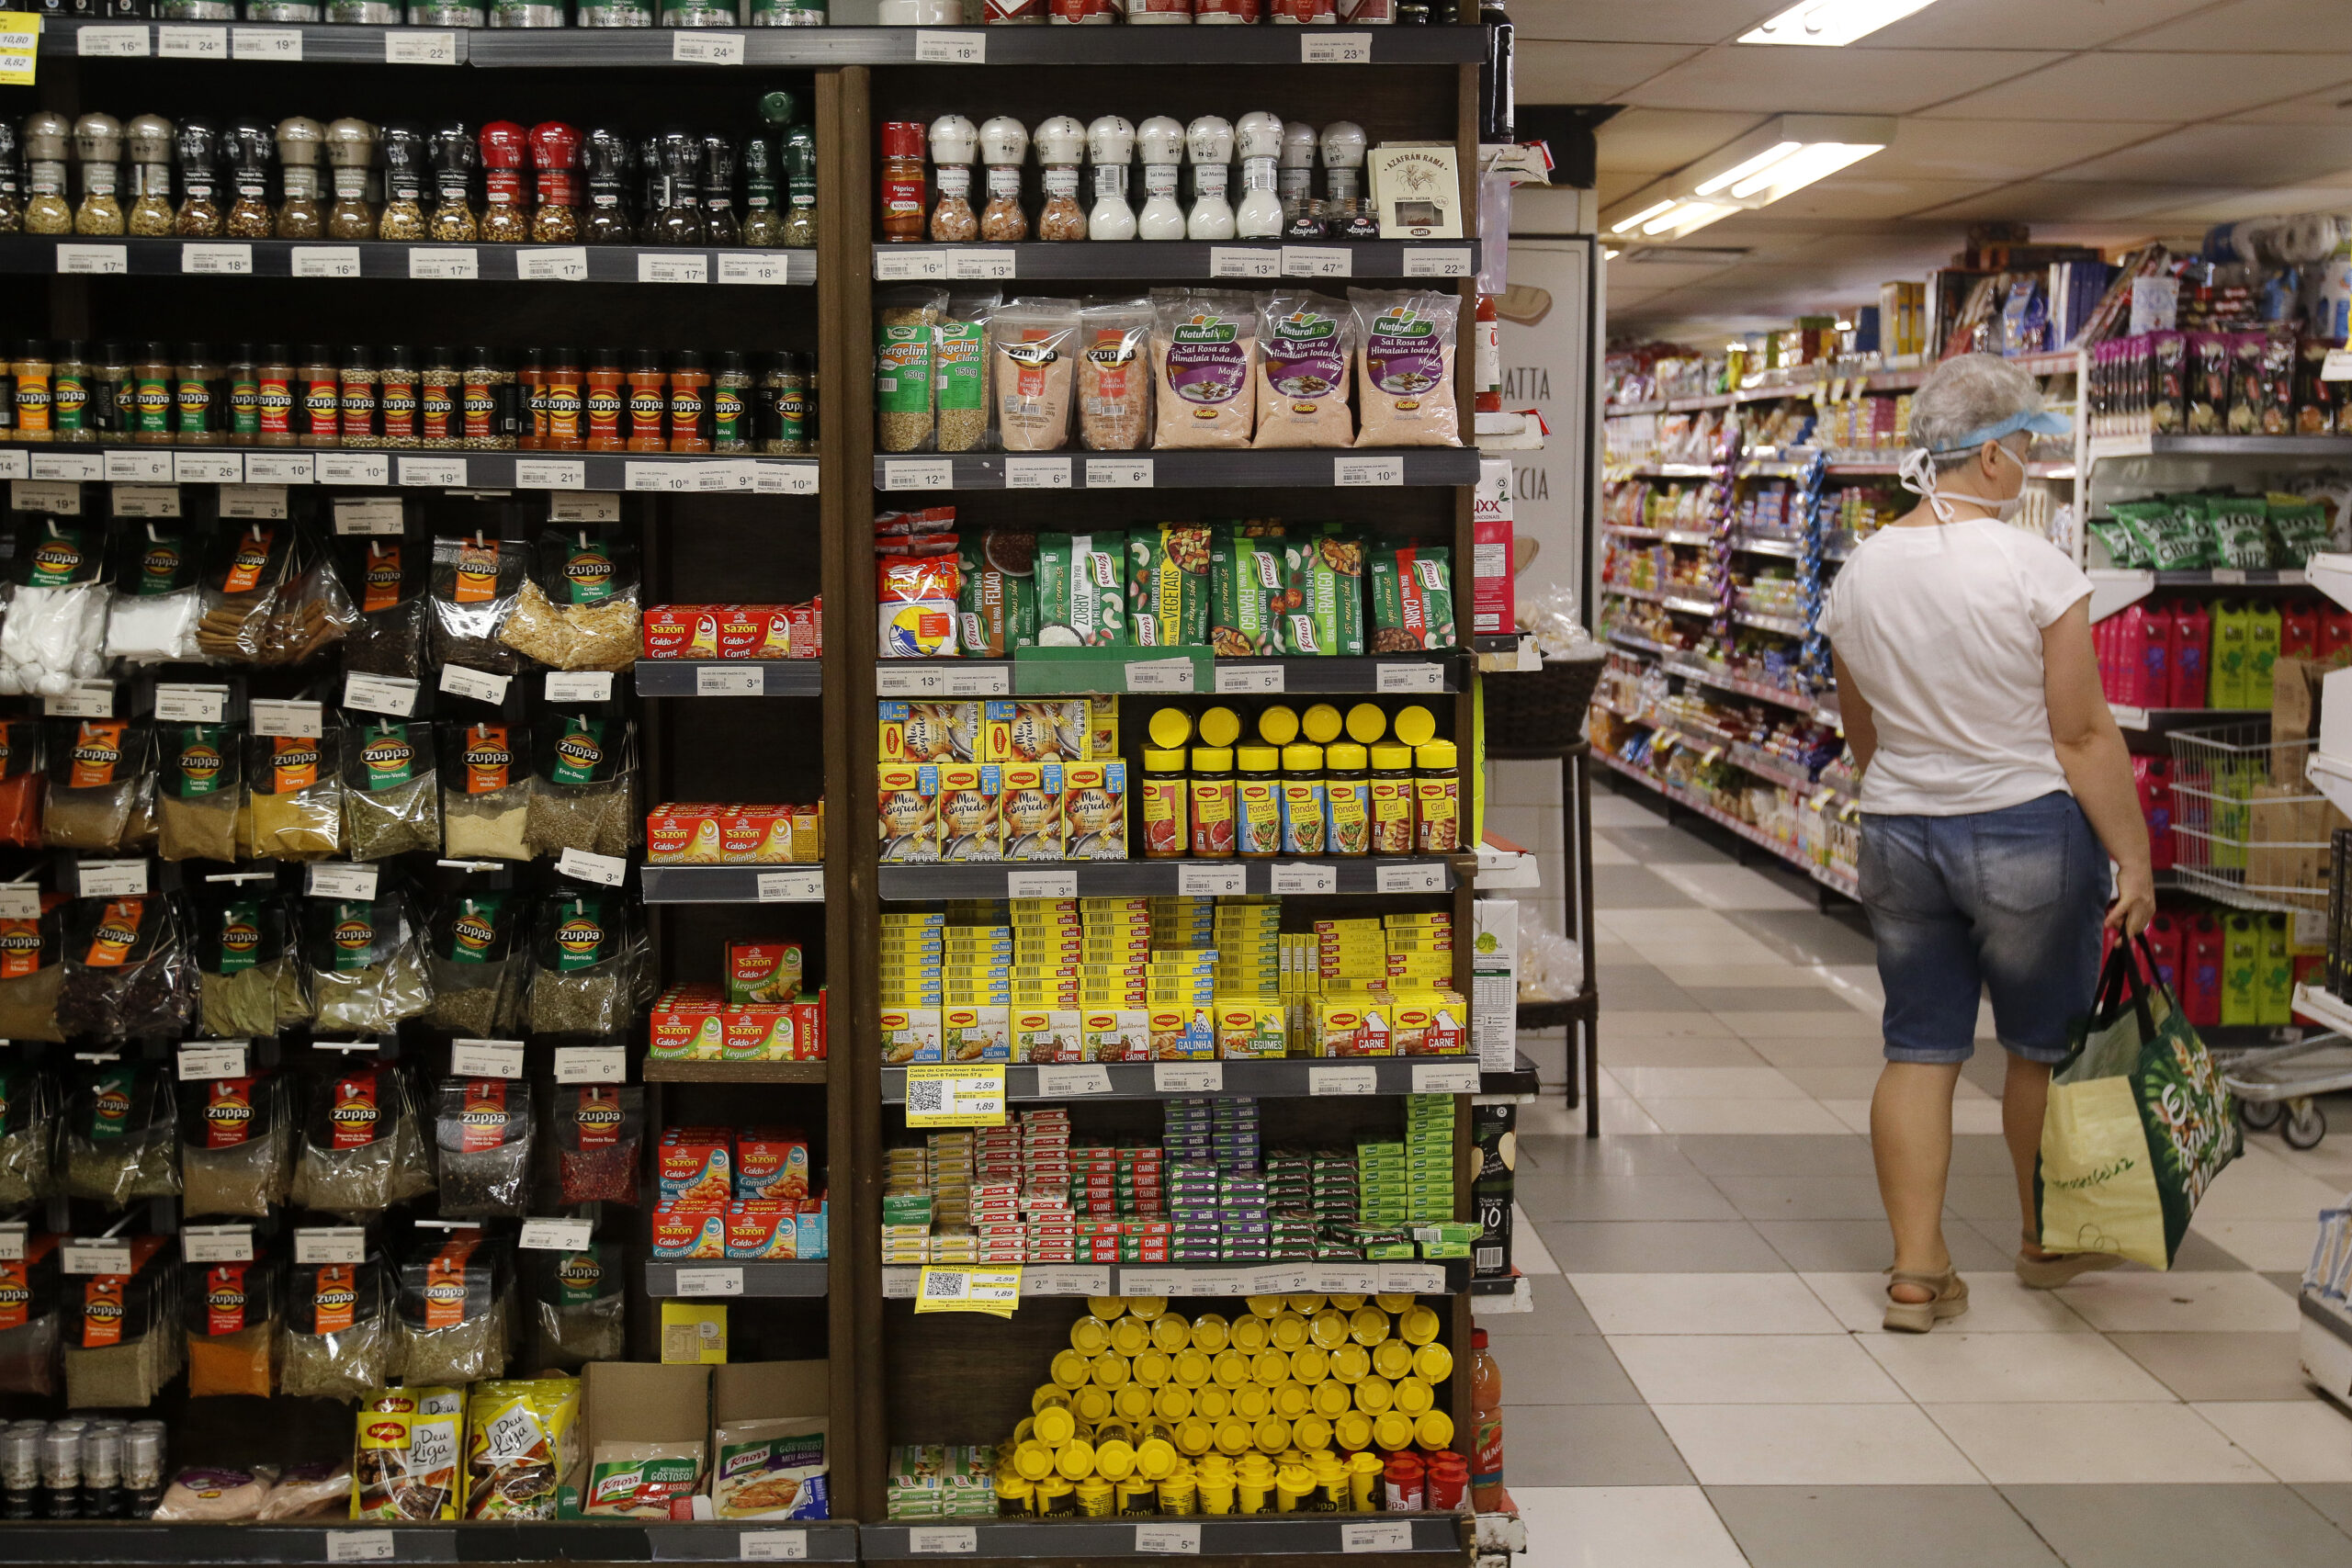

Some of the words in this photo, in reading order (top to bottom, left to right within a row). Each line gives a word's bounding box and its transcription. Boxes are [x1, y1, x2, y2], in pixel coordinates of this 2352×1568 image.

[1381, 338, 1395, 346] Sal
[1396, 338, 1416, 346] Rosa
[904, 356, 928, 366] Claro
[956, 354, 979, 362] Claro
[955, 367, 978, 378] 150g
[1162, 570, 1180, 619] VEGETAIS
[1317, 572, 1334, 614] FRANGO
[1073, 593, 1090, 626] ARROZ
[1239, 588, 1257, 630] FRANGO
[1404, 599, 1422, 629] CARNE
[1248, 802, 1276, 814] Fondor
[1290, 802, 1318, 815] Fondor
[1333, 802, 1362, 815] Fondor
[1249, 1040, 1283, 1051] LEGUMES
[1358, 1039, 1386, 1049] CARNE
[1428, 1037, 1455, 1048] CARNE
[975, 1081, 995, 1090] 2,59
[975, 1102, 994, 1111] 1,89
